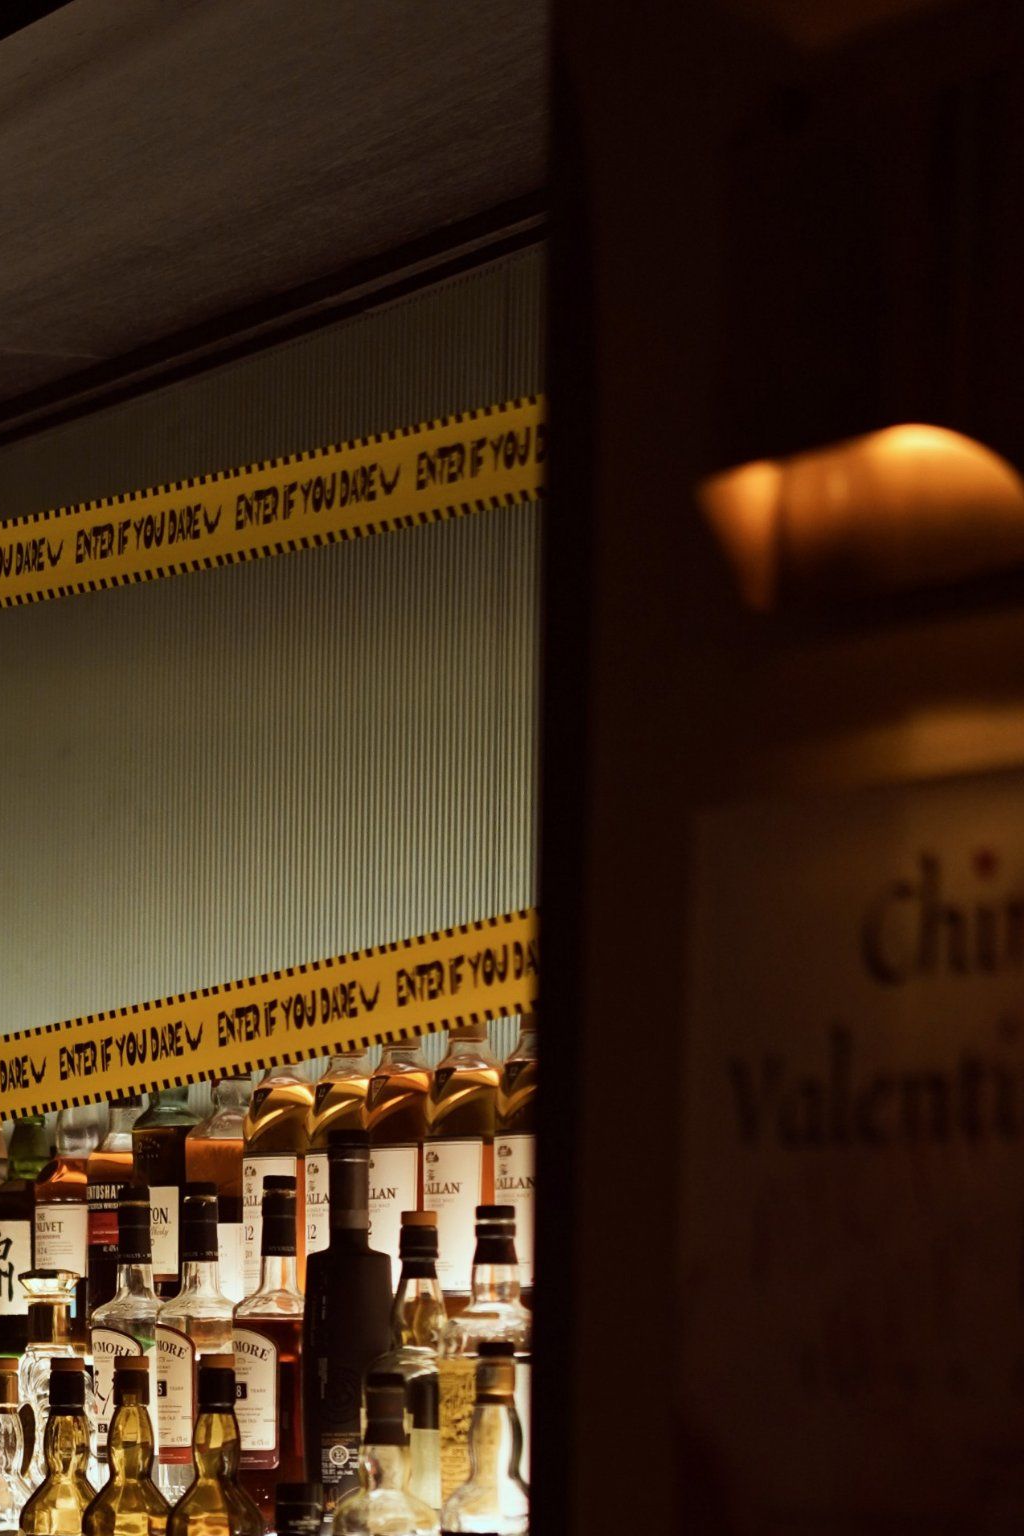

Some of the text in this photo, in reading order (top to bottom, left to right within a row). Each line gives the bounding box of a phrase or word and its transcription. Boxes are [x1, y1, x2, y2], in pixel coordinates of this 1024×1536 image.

[15, 537, 45, 575] DARE
[76, 523, 114, 564] ENTER
[118, 519, 131, 555] IF
[134, 511, 165, 549] YOU
[168, 503, 202, 545] DARE
[235, 486, 279, 530] ENTER
[282, 481, 297, 520] IF
[301, 471, 337, 514] YOU
[340, 463, 378, 507] DARE
[416, 442, 465, 490] ENTER
[470, 437, 486, 478] IF
[490, 426, 531, 471] YOU
[0, 1055, 29, 1093] DARE
[59, 1040, 97, 1080] ENTER
[101, 1036, 112, 1072] IF
[115, 1028, 146, 1066] YOU
[151, 1021, 184, 1062] DARE
[218, 1004, 260, 1047] ENTER
[264, 999, 278, 1037] IF
[281, 990, 316, 1029] YOU
[320, 979, 358, 1024] DARE
[396, 959, 444, 1007] ENTER
[448, 954, 465, 995] IF
[467, 944, 508, 986] YOU
